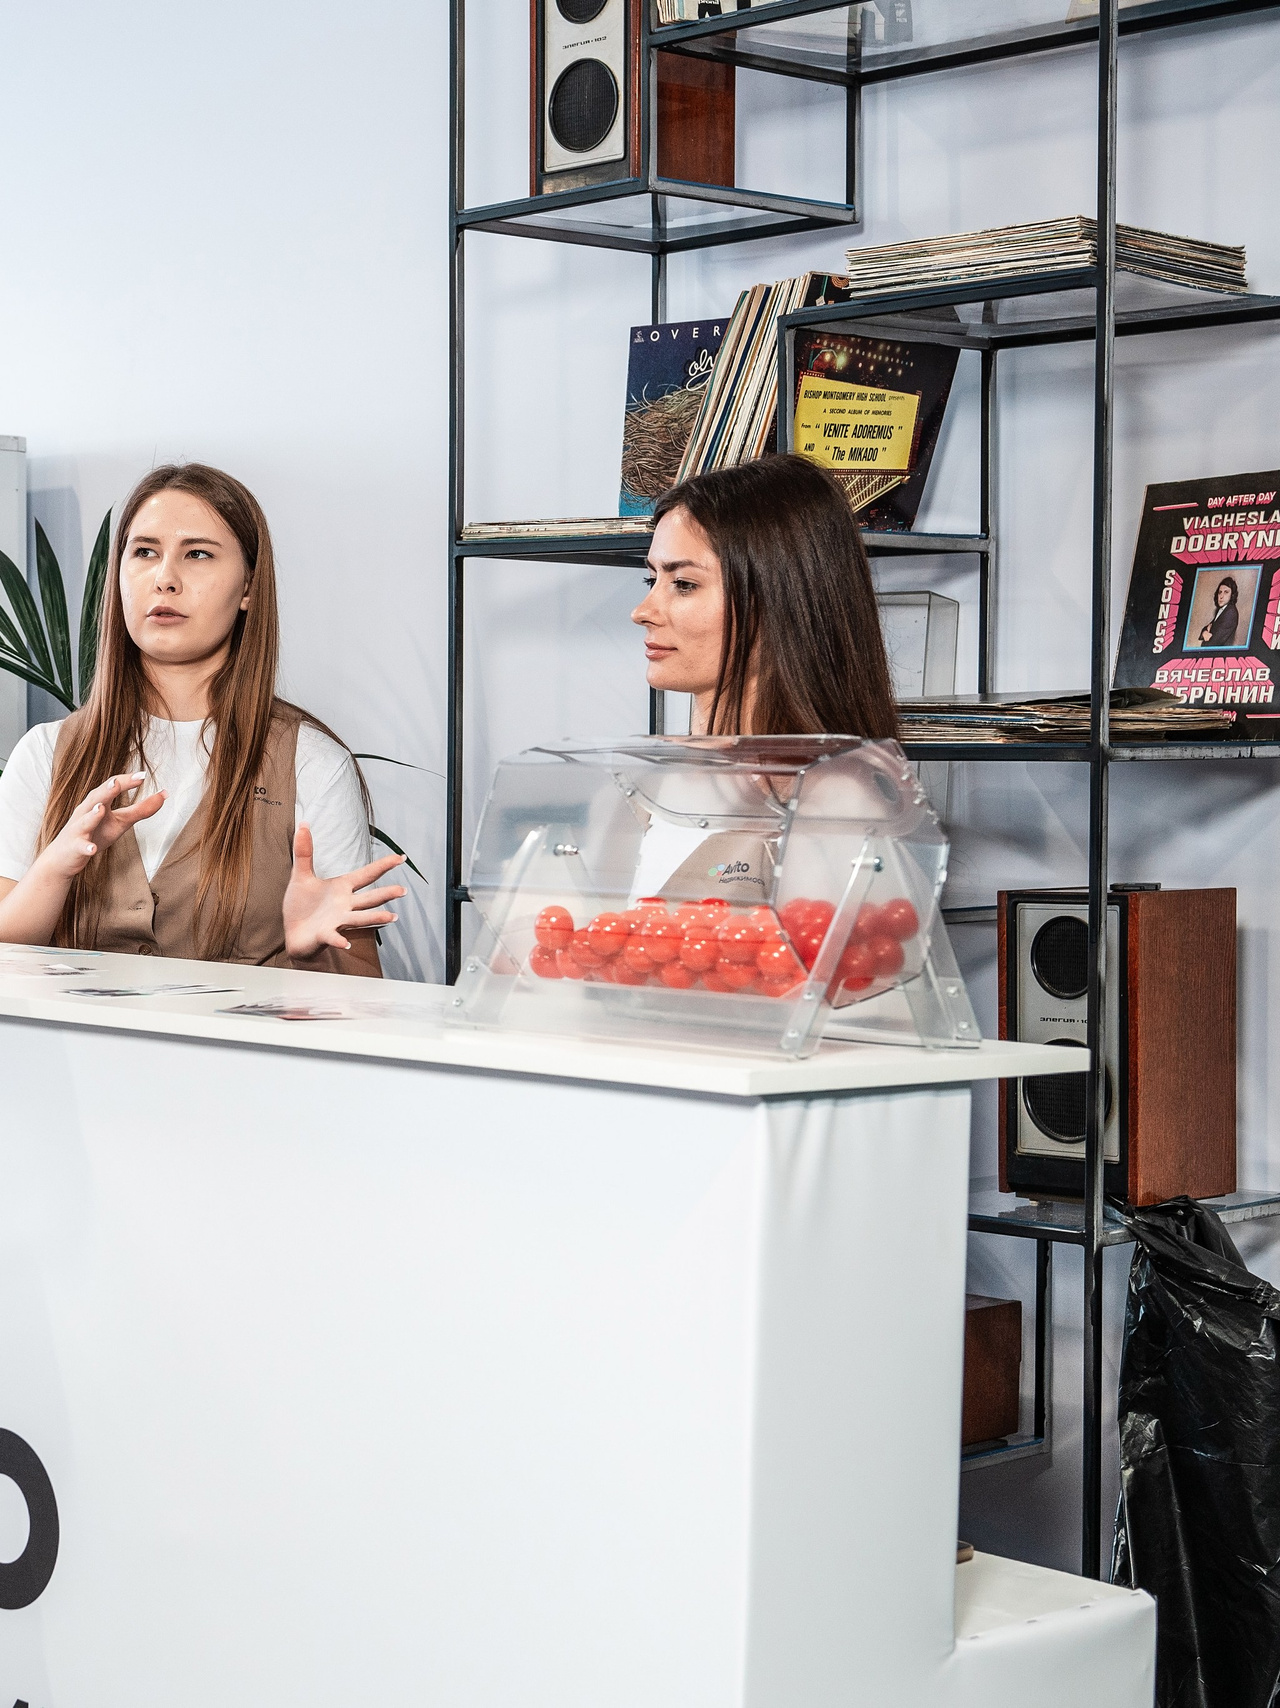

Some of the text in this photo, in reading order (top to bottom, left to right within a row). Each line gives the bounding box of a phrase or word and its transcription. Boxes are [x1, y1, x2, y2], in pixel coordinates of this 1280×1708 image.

[650, 325, 720, 342] OVER
[804, 390, 822, 400] BISHOP
[822, 390, 855, 401] MONTGOMERY
[856, 391, 868, 401] HIGH
[869, 392, 886, 402] SCHOOL
[823, 423, 850, 438] VENITE
[851, 424, 894, 439] ADOREMUS
[804, 443, 878, 462] AND The MIKADO
[1208, 491, 1277, 507] DAY AFTER DAY
[1152, 569, 1176, 654] SONGS
[1155, 667, 1270, 684] ВЯЧЕСЛАВ
[722, 861, 750, 876] Avito
